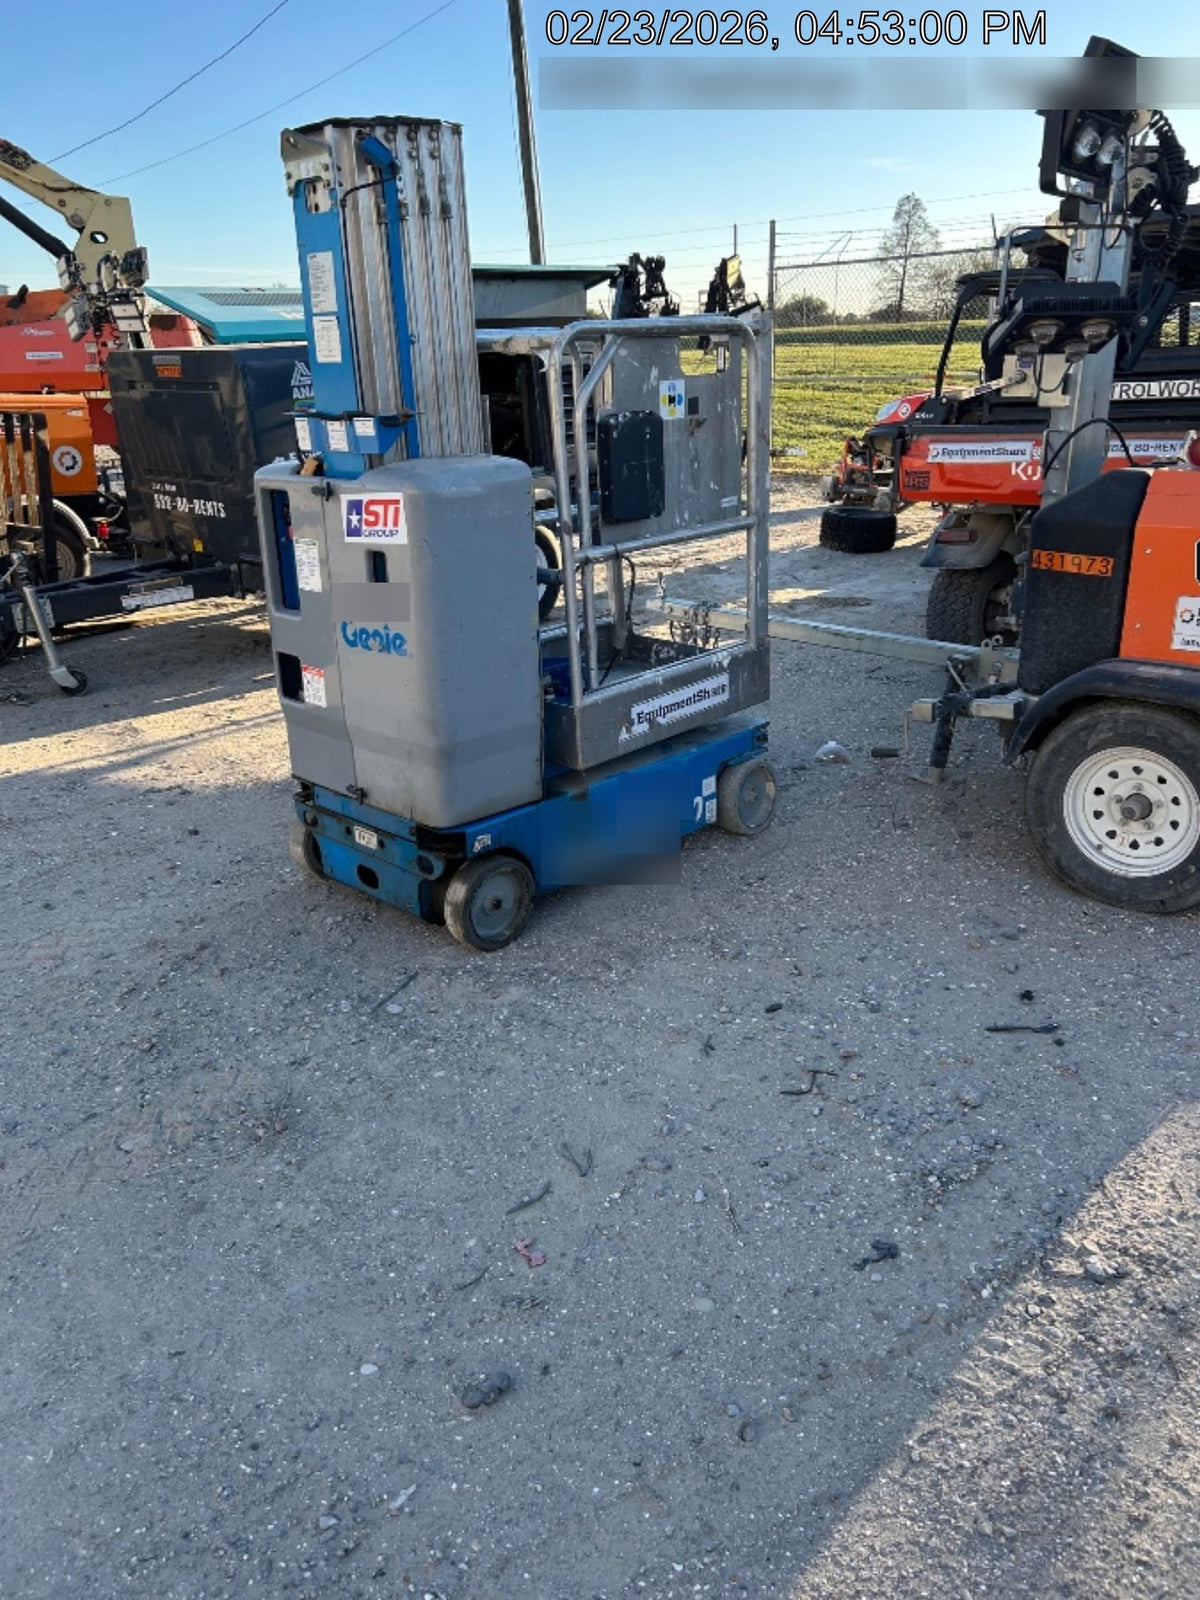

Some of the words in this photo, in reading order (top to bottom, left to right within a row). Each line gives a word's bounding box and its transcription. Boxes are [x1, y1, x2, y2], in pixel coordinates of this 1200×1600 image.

[363, 499, 401, 529] STI
[363, 529, 399, 539] GROUP
[1031, 552, 1111, 576] 431973
[340, 621, 409, 657] Genie
